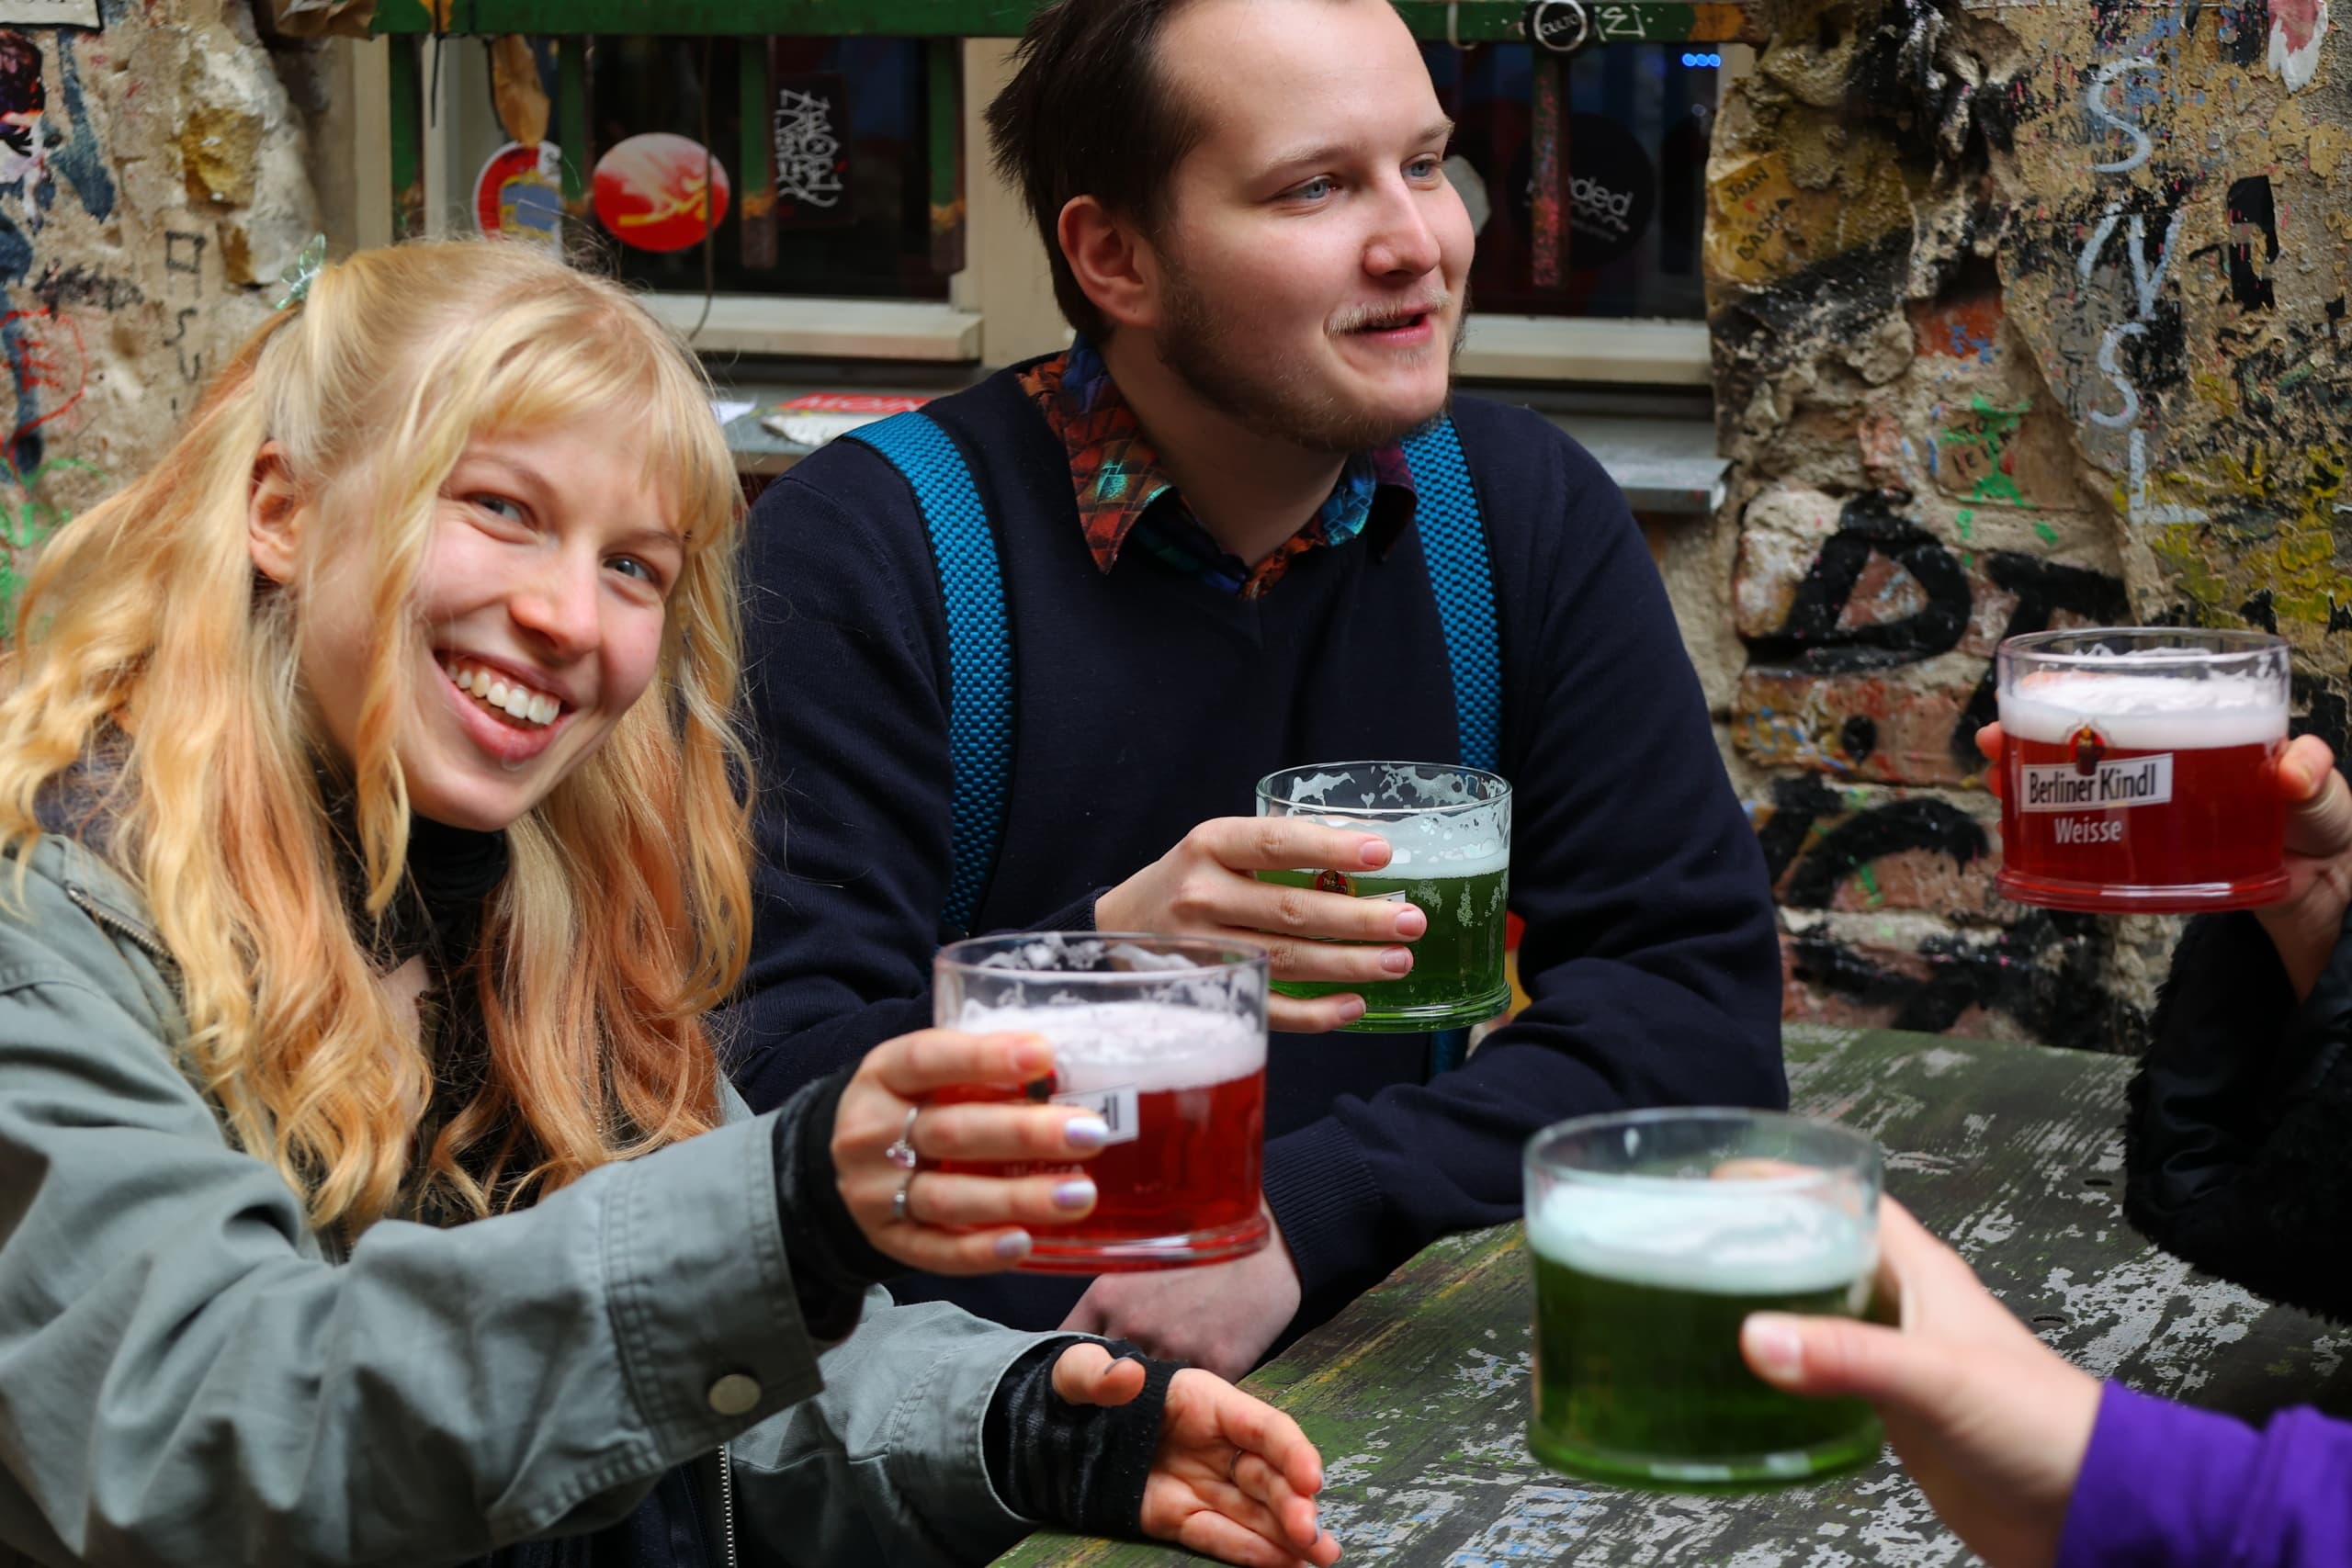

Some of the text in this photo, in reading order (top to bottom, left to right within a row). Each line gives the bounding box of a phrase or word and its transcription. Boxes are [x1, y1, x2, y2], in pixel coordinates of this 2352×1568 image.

[2030, 763, 2156, 804] Berliner Kindl
[2054, 817, 2122, 844] Weisse
